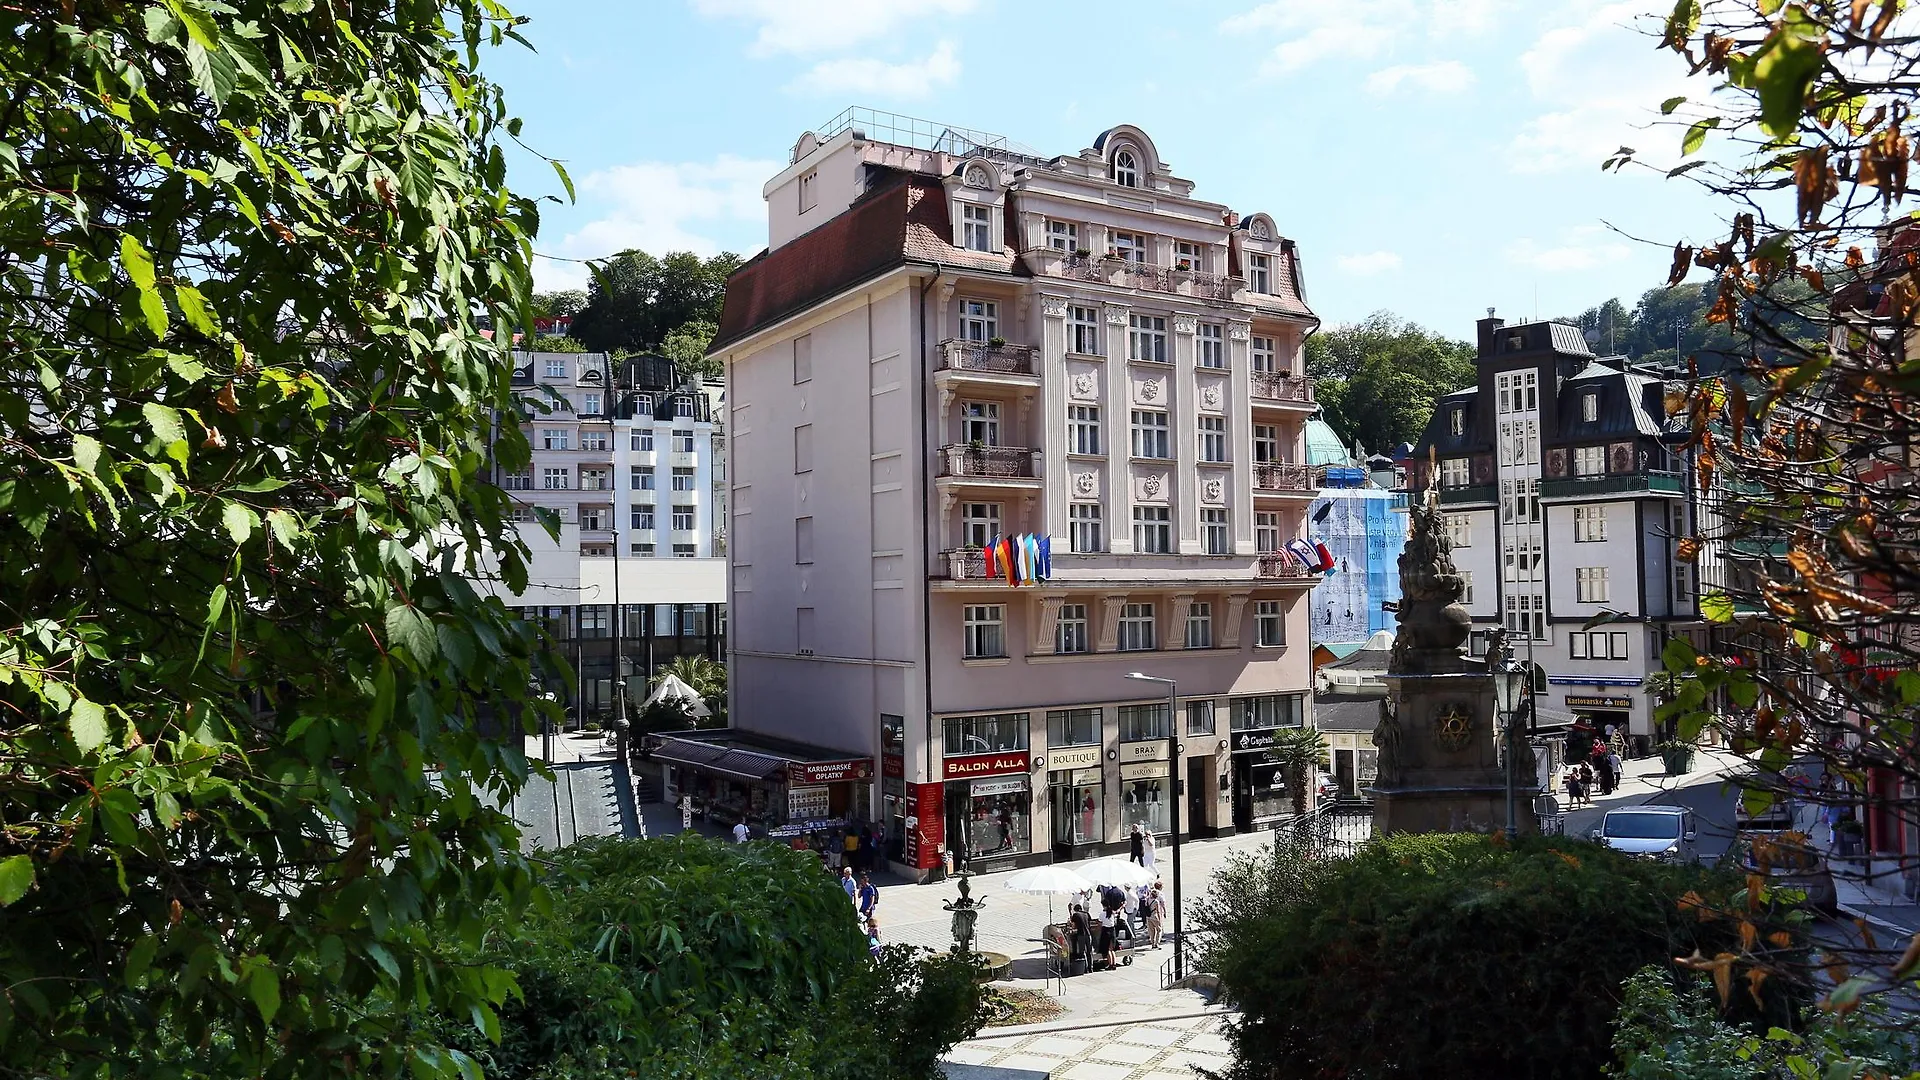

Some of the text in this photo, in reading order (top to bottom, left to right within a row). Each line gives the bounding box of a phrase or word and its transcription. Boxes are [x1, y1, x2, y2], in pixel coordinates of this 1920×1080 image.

[1368, 515, 1379, 524] Pro
[1134, 746, 1155, 755] BRAX
[1053, 752, 1097, 765] BOUTIQUE
[807, 762, 852, 773] KARLOVARSKÉ
[815, 772, 844, 780] OPLATKY
